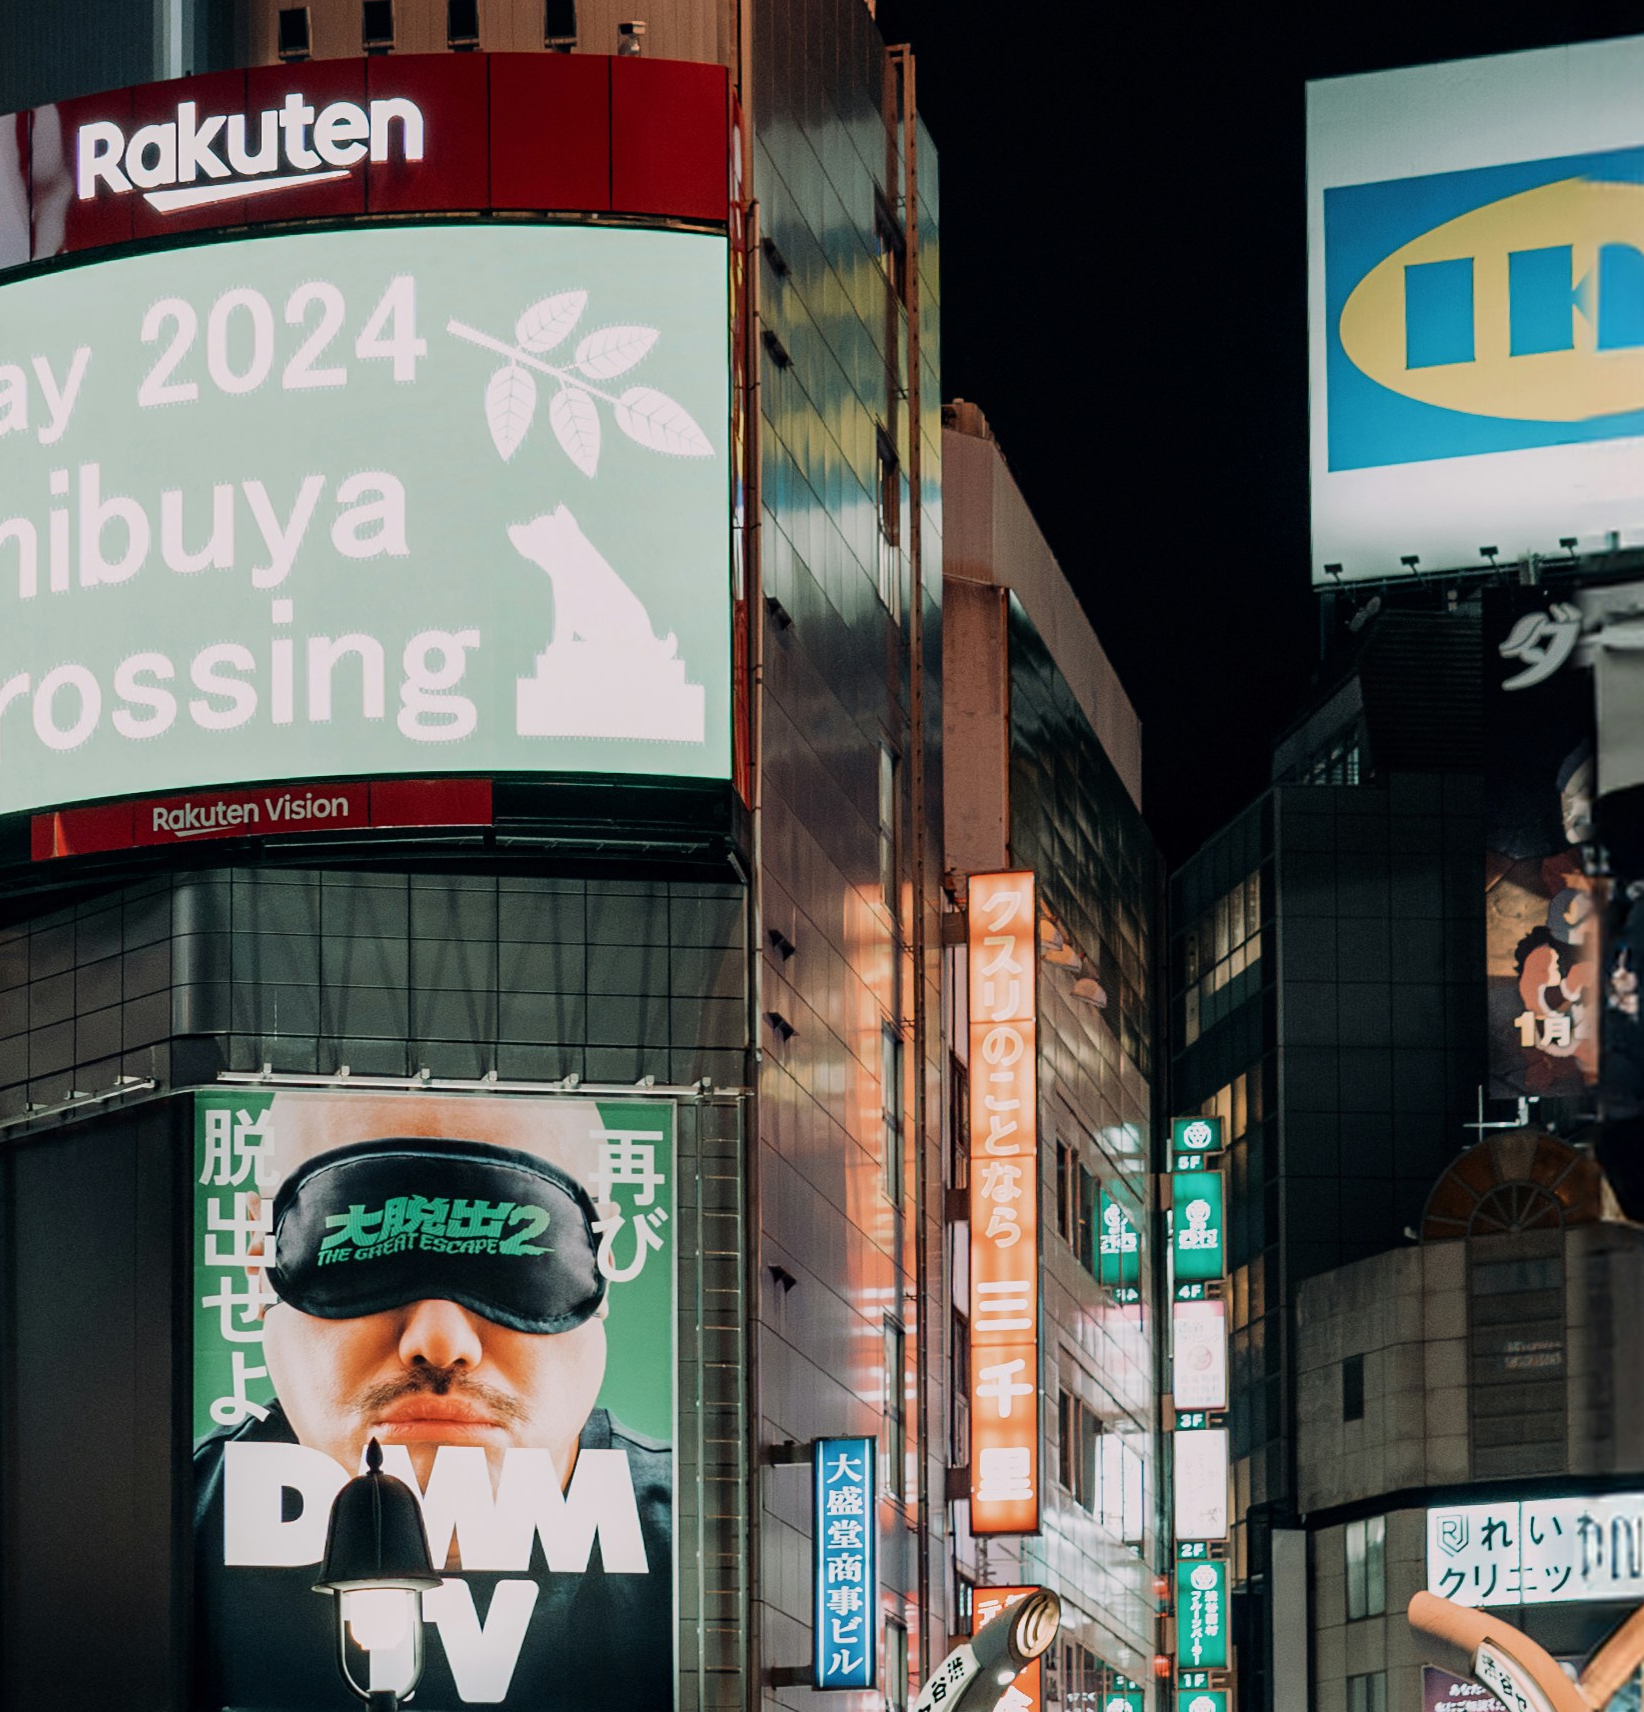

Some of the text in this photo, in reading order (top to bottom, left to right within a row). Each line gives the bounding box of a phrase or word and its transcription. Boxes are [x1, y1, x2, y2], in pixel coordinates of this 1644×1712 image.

[78, 92, 424, 203] Rakuten
[138, 274, 427, 408] 2024
[152, 790, 350, 835] Rakuten Vision
[1178, 1155, 1201, 1170] 5F
[588, 1129, 669, 1283] 再び
[975, 889, 1035, 1504] クスリのことなら 三千里
[317, 1235, 499, 1267] THE GREAT ESCAPE
[322, 1194, 556, 1259] 大脱出2
[198, 1107, 282, 1426] 脱出せよ
[1178, 1283, 1202, 1300] 4F
[1180, 1413, 1204, 1428] 3F
[825, 1451, 865, 1676] 大盛堂商事ビル
[1181, 1543, 1205, 1558] 2F
[1183, 1673, 1205, 1688] 1F
